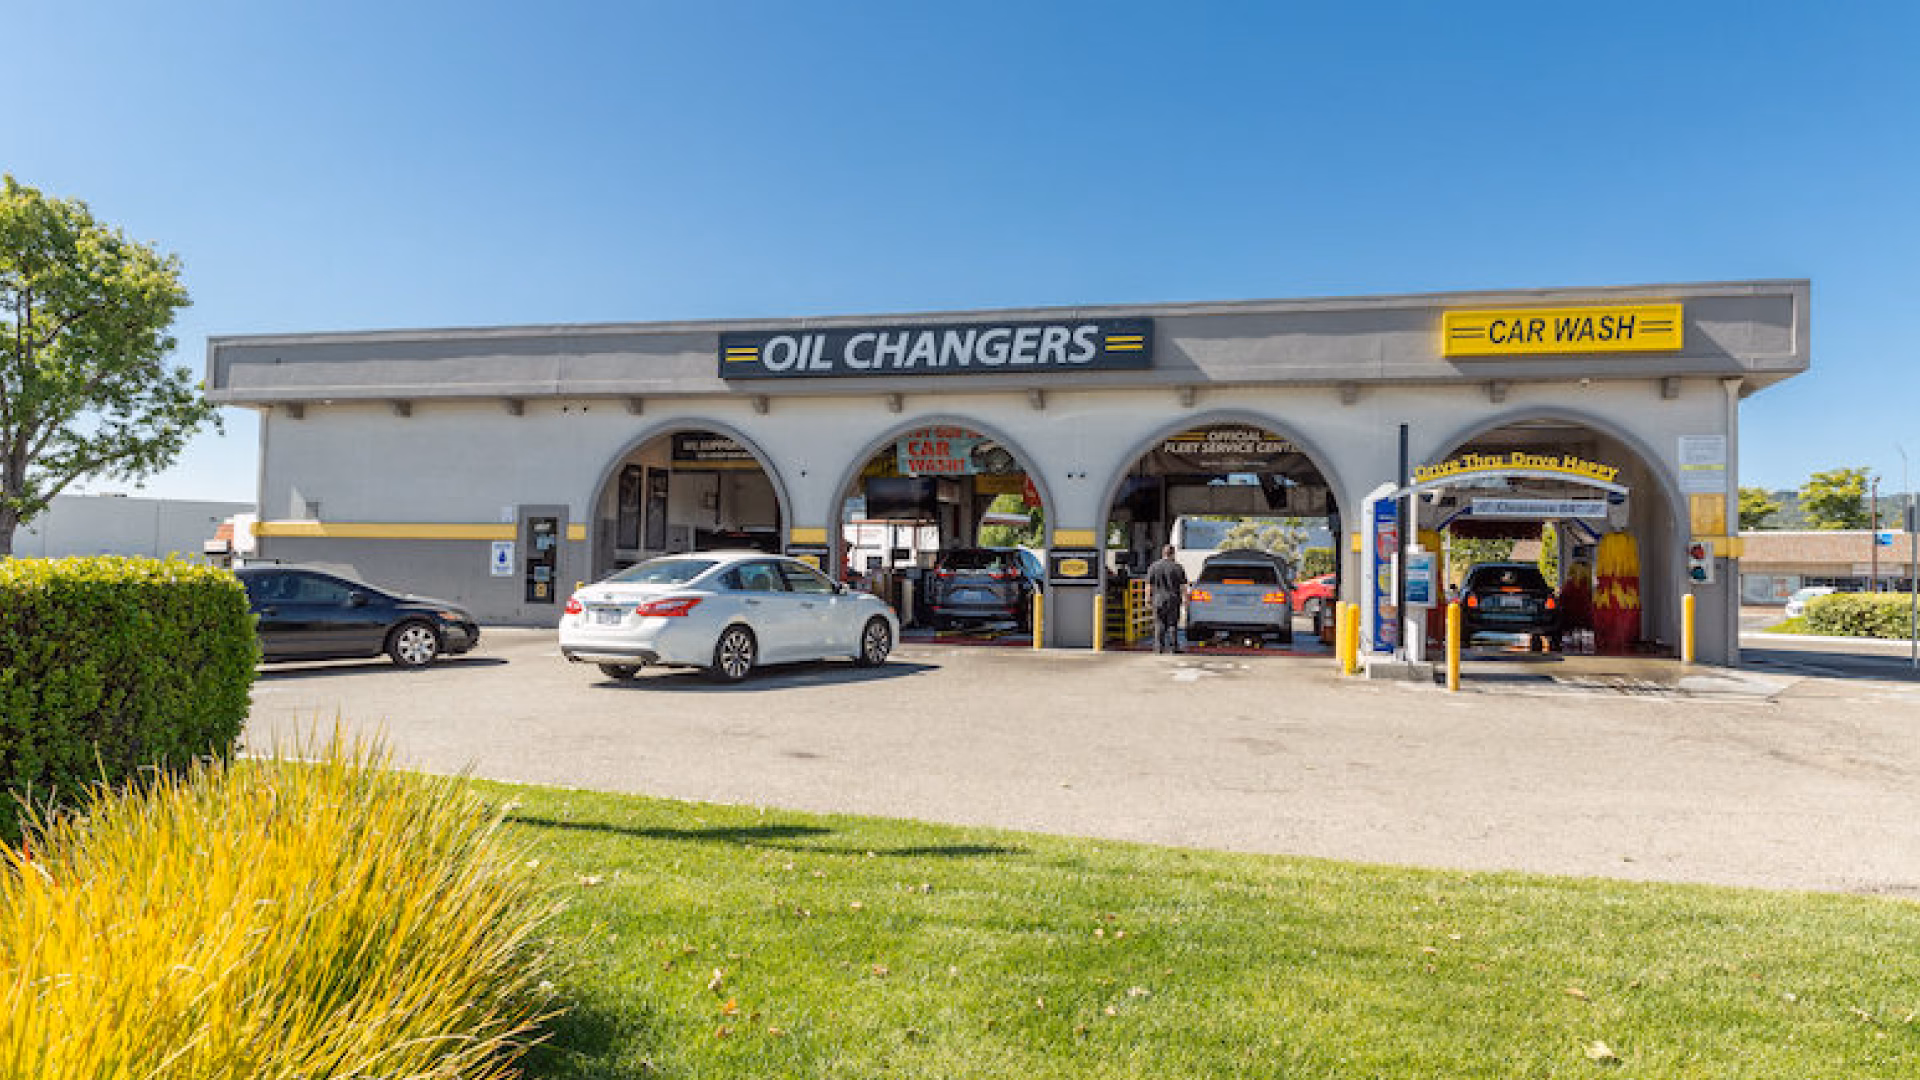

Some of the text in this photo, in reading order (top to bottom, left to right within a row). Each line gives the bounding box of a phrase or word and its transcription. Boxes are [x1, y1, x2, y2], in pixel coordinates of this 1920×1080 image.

[1489, 315, 1636, 344] CAR WASH
[762, 325, 1099, 371] OIL CHANGERS
[1208, 431, 1261, 442] OFFICIAL
[907, 442, 950, 456] CAR
[1164, 442, 1198, 453] FLEET
[1201, 442, 1255, 453] SERVICE
[1415, 460, 1461, 481] Drive
[1511, 452, 1559, 469] Drive
[1564, 455, 1620, 482] Happy
